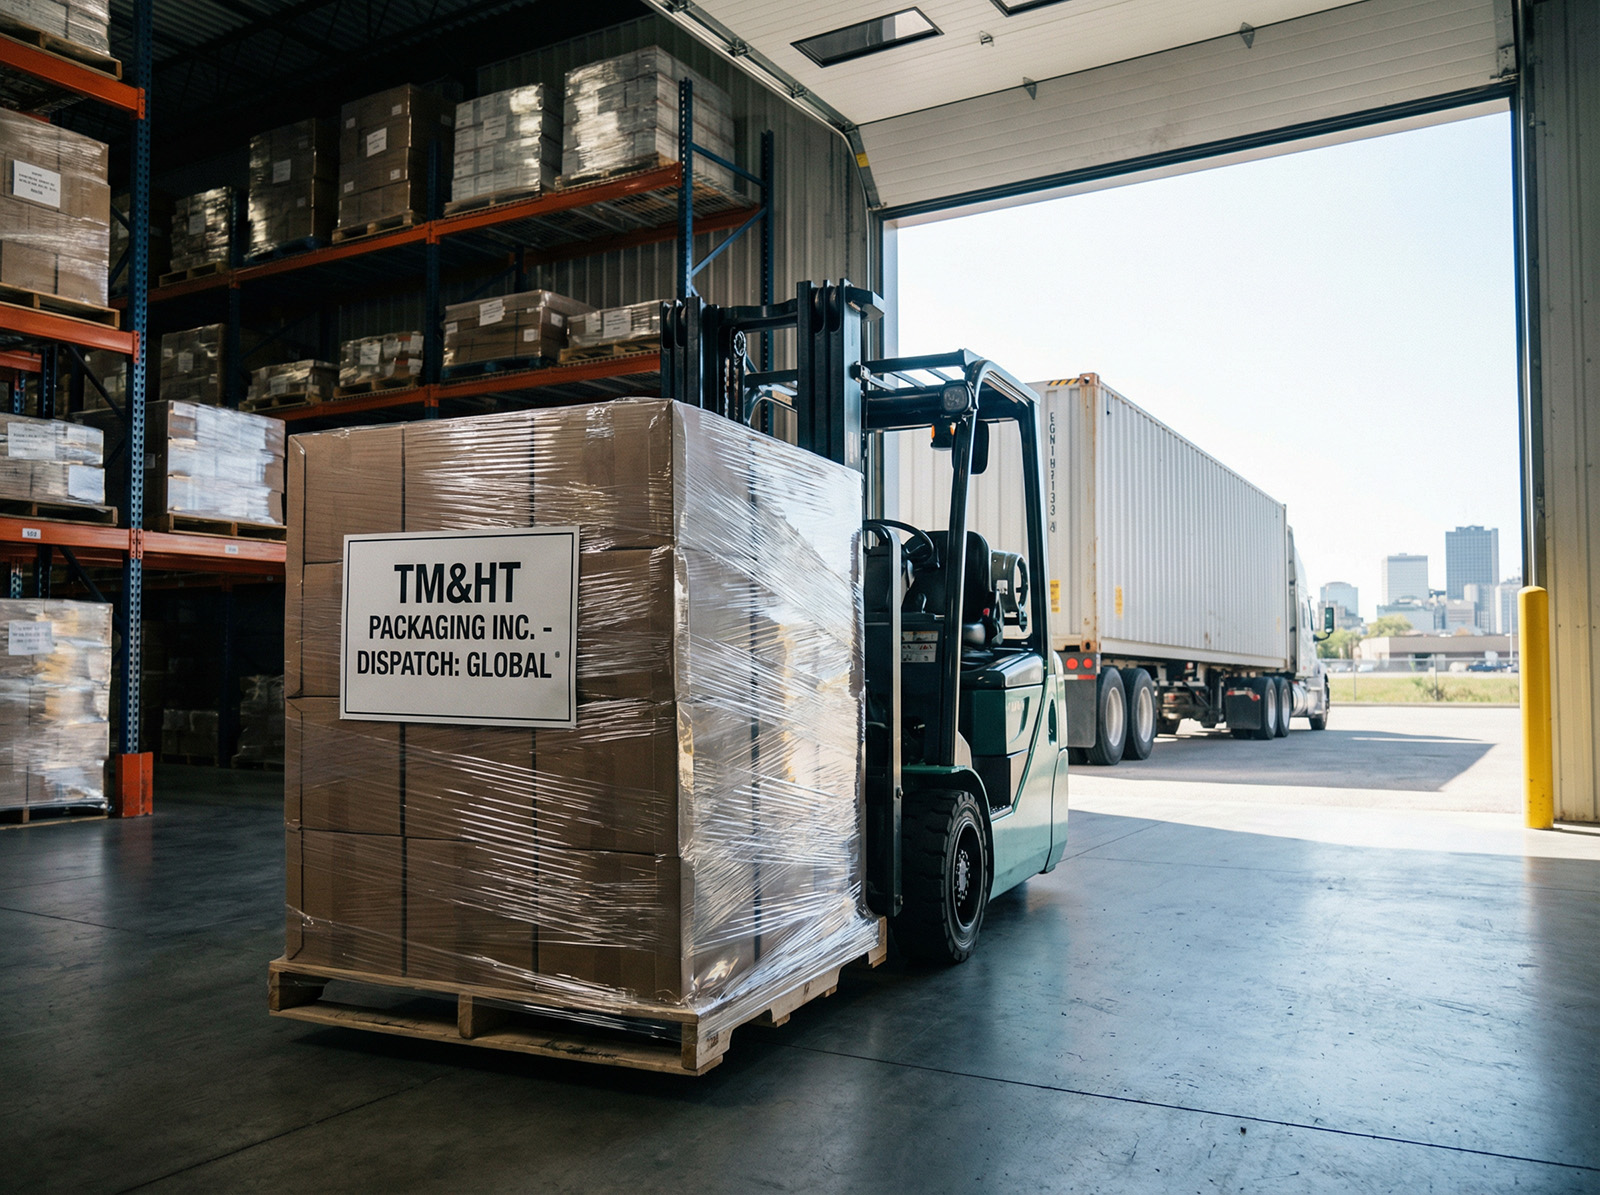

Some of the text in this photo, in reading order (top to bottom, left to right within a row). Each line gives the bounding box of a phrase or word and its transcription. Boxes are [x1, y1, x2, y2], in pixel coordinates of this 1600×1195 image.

[394, 562, 522, 603] TM&HT
[369, 614, 485, 640] PACKAGING
[493, 614, 535, 640] INC.
[357, 650, 552, 679] DISPATCH: GLOBAL
